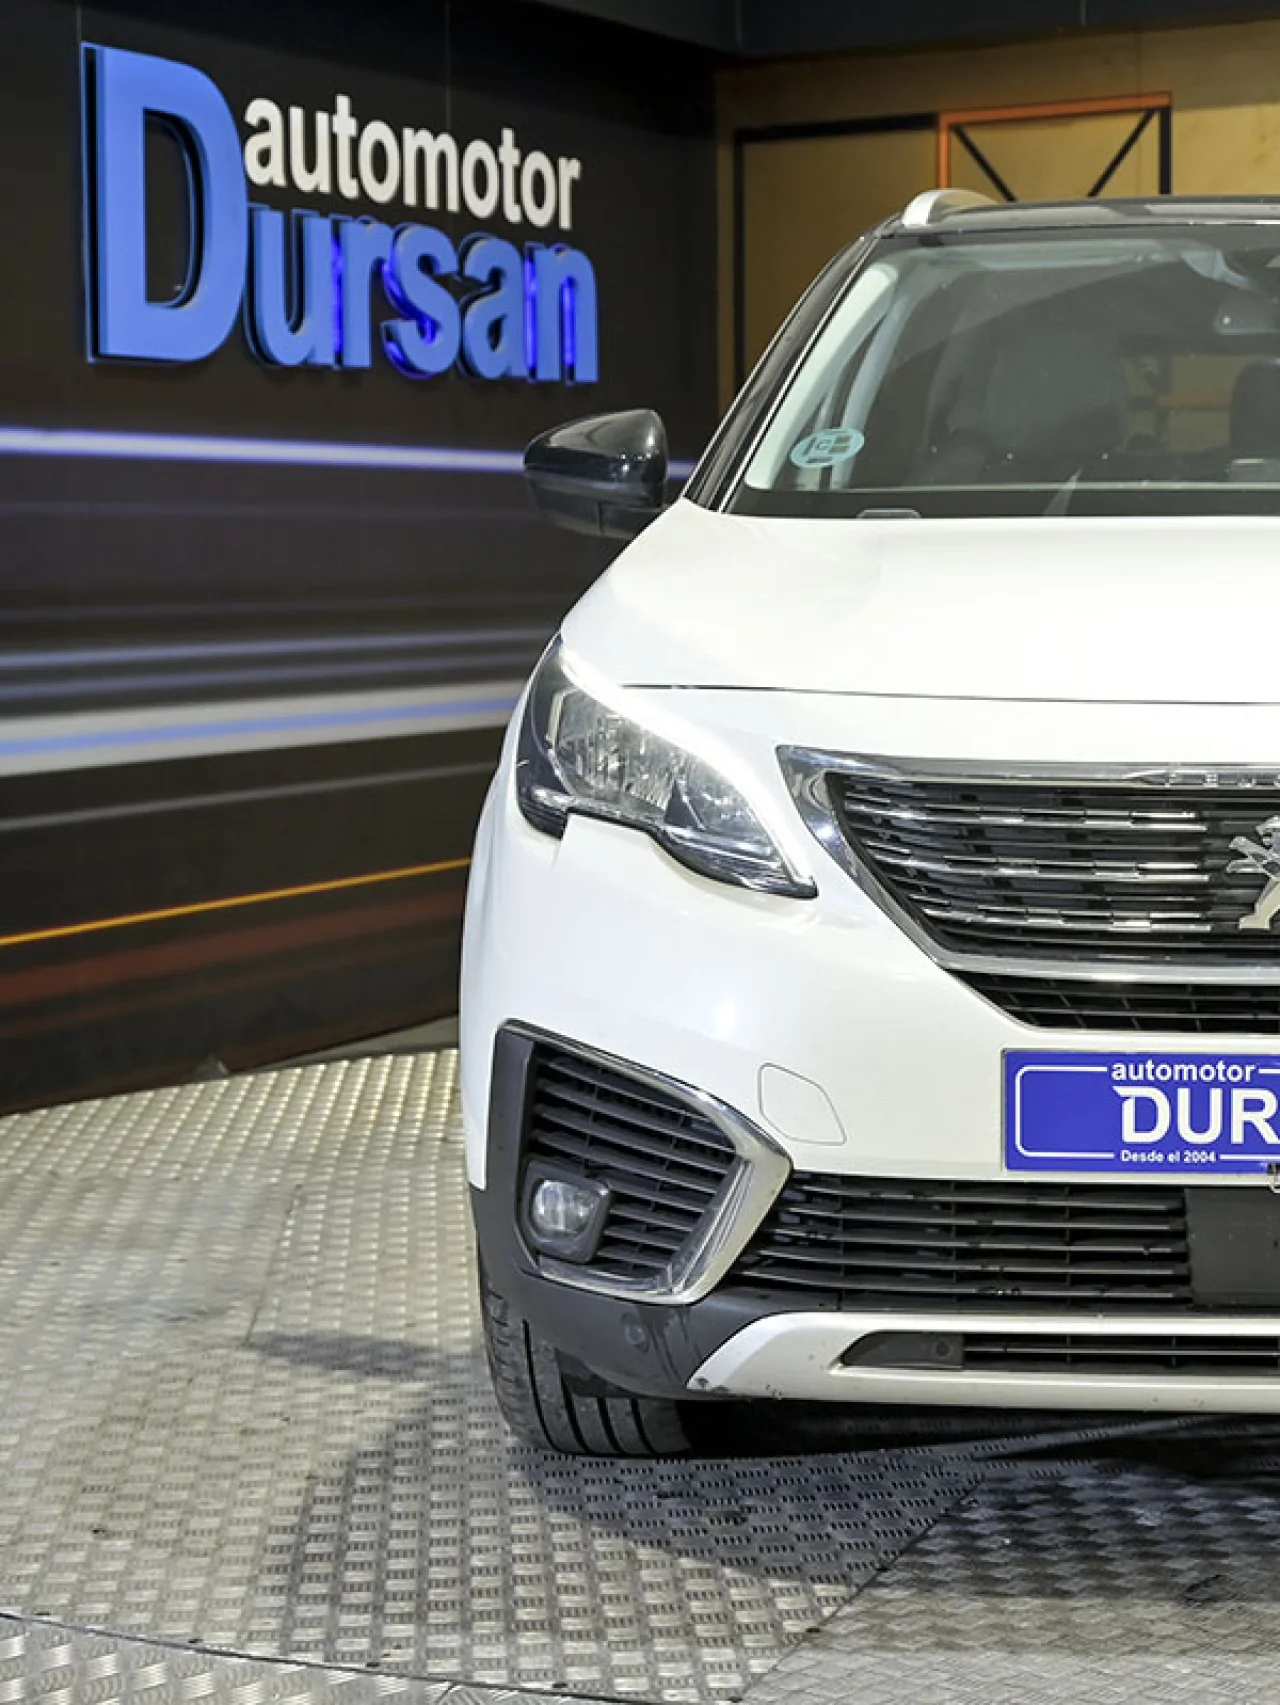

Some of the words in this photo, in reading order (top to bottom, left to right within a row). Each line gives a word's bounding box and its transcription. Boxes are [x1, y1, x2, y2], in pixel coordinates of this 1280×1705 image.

[243, 94, 580, 229] automotor
[81, 41, 598, 385] Dursan
[1111, 1060, 1256, 1082] automotor
[1121, 1150, 1164, 1163] Desde
[1168, 1151, 1181, 1163] el
[1183, 1150, 1216, 1164] 2004
